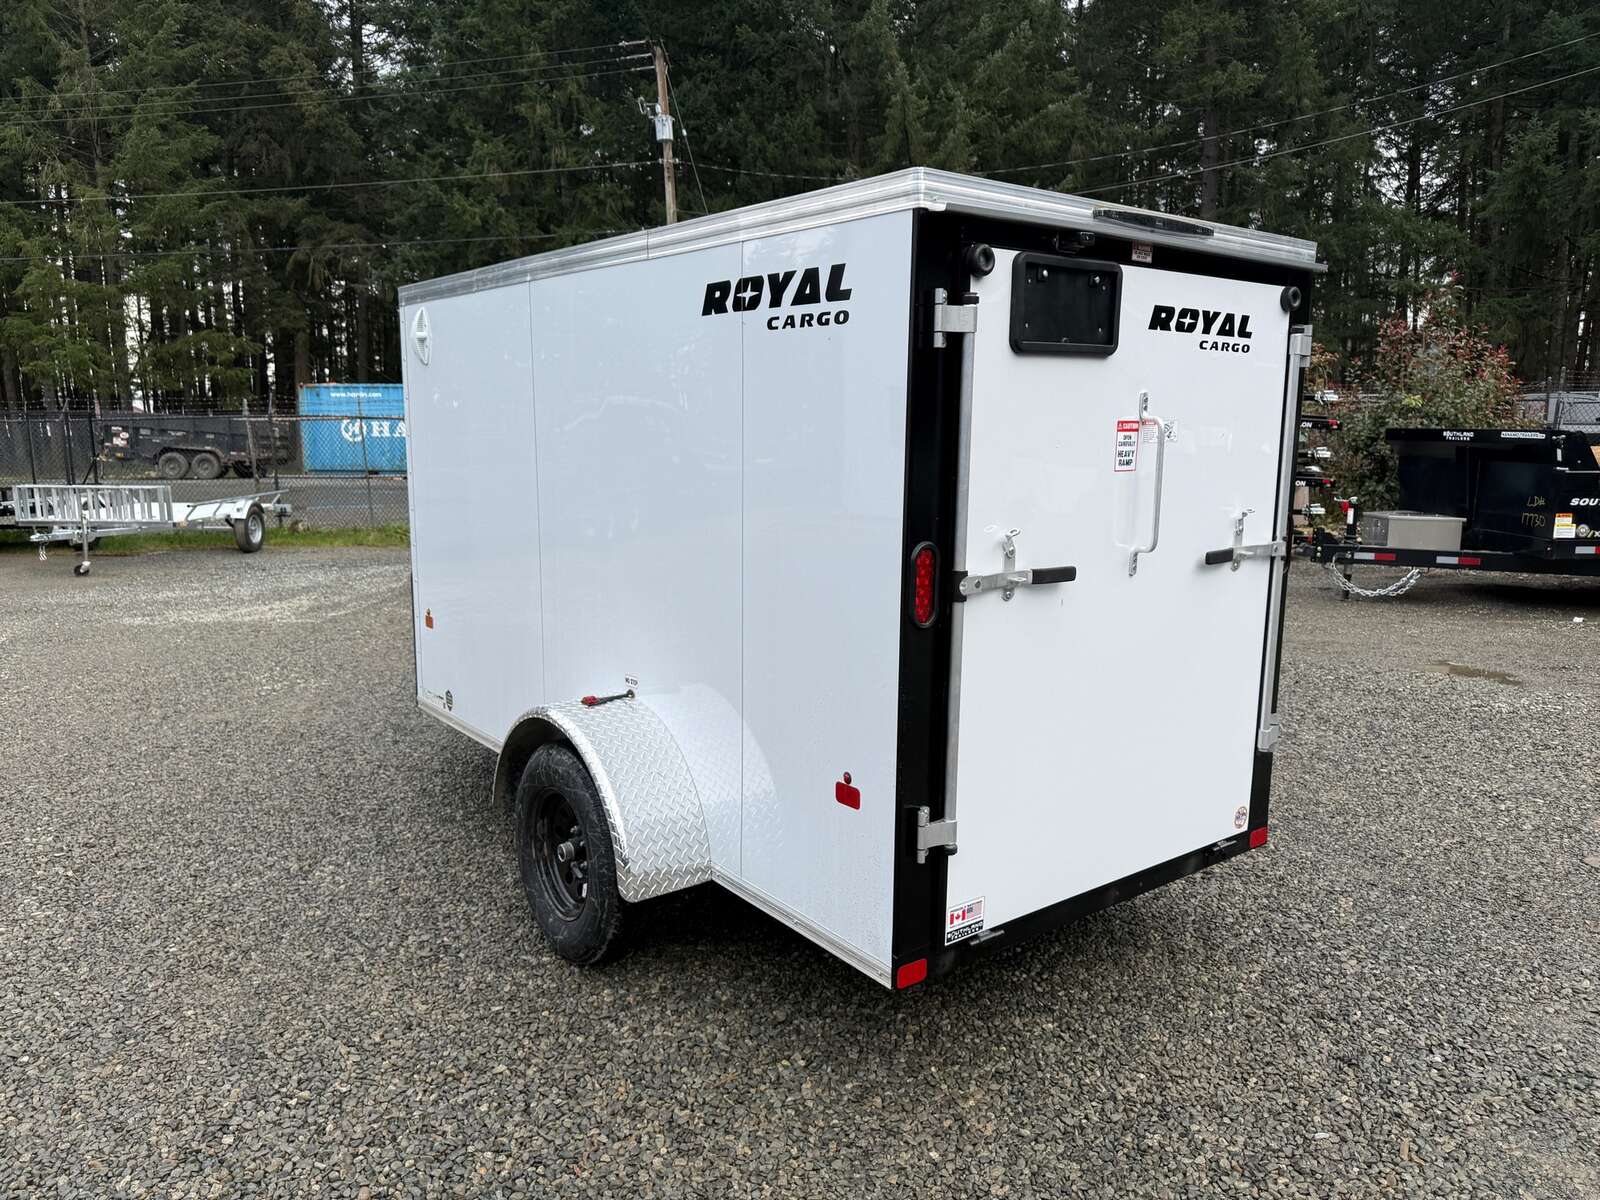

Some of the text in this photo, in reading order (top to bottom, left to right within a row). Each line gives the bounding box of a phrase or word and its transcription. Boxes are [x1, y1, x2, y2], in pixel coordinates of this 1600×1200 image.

[702, 263, 852, 316] ROYAL
[767, 310, 850, 330] CARGO
[1148, 304, 1253, 339] ROYAL
[1199, 340, 1250, 353] CARGO
[1118, 450, 1134, 458] HEAVY
